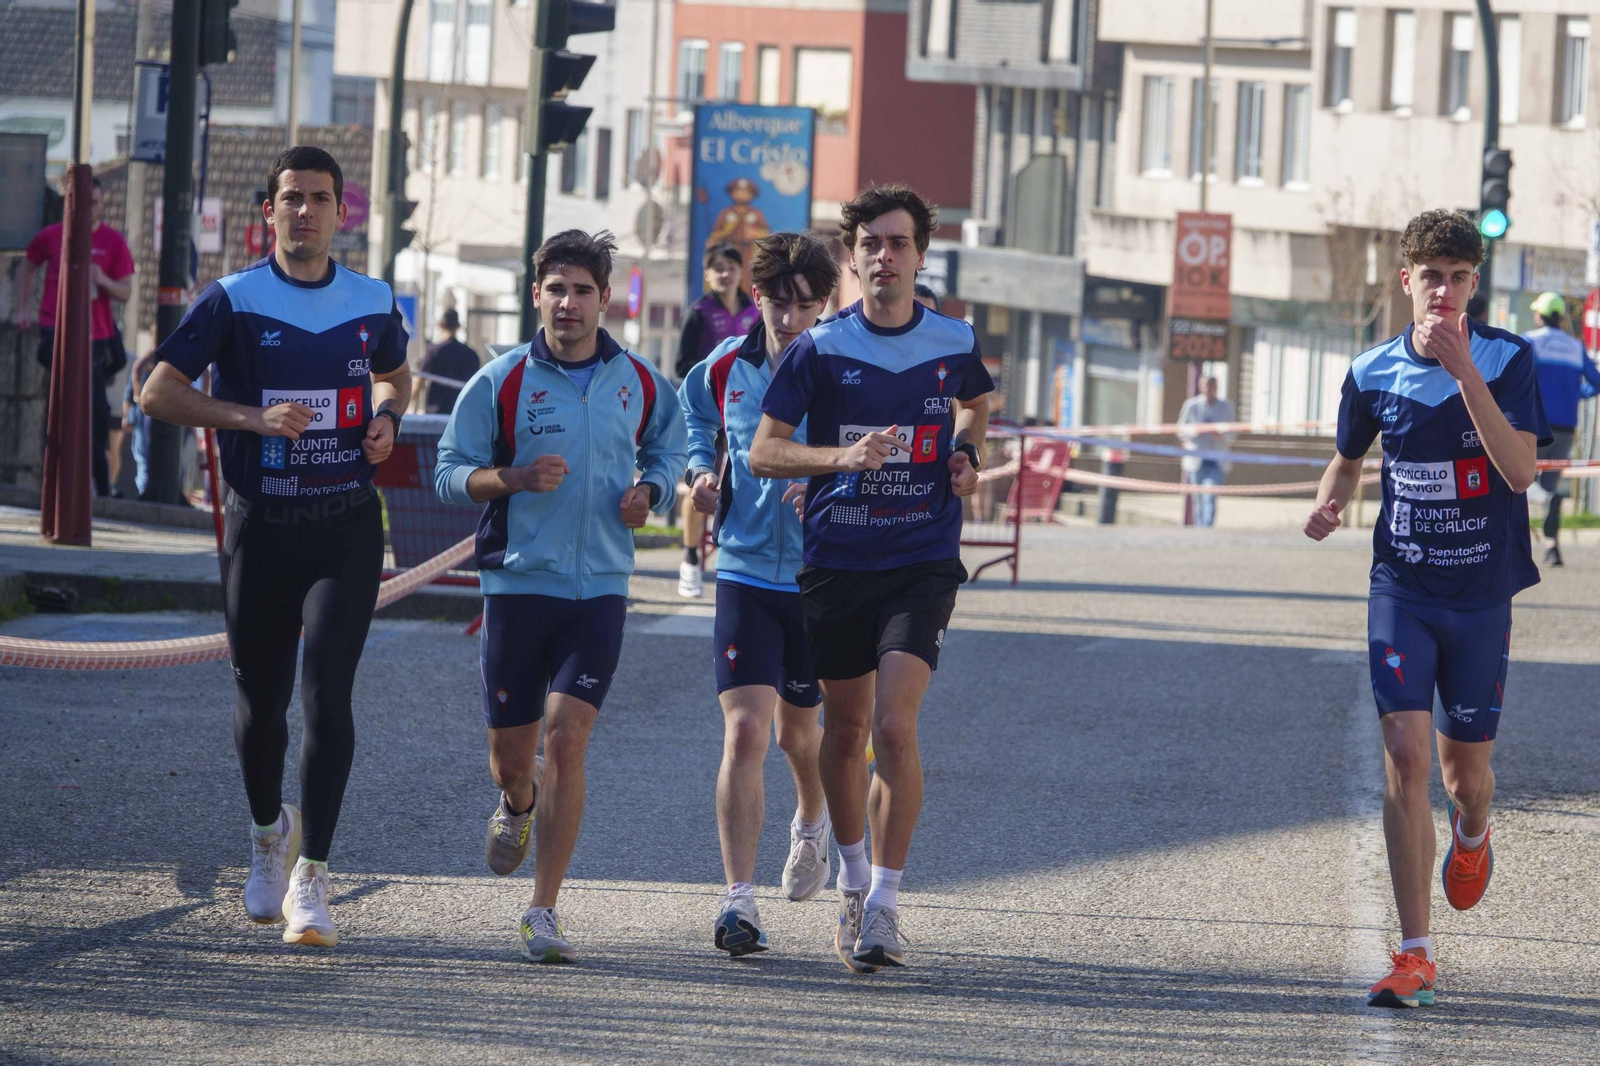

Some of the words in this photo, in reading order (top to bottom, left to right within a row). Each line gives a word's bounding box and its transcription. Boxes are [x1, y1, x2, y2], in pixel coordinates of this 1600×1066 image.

[708, 109, 804, 139] Albergue
[701, 137, 725, 163] El
[731, 138, 807, 164] Cristo
[1172, 334, 1226, 359] 2026
[291, 437, 338, 451] XUNTA
[290, 453, 308, 465] DE
[311, 449, 361, 465] GALICIA
[863, 470, 910, 482] XUNTA
[1396, 468, 1448, 480] CONCELLO
[861, 483, 878, 495] DE
[1398, 481, 1413, 491] DE
[1414, 484, 1442, 493] VIGO
[263, 485, 374, 524] UNDE
[1415, 508, 1461, 520] XUNTA
[1415, 521, 1432, 533] DE
[1428, 541, 1491, 558] Deputación
[1448, 711, 1472, 723] ZICO
